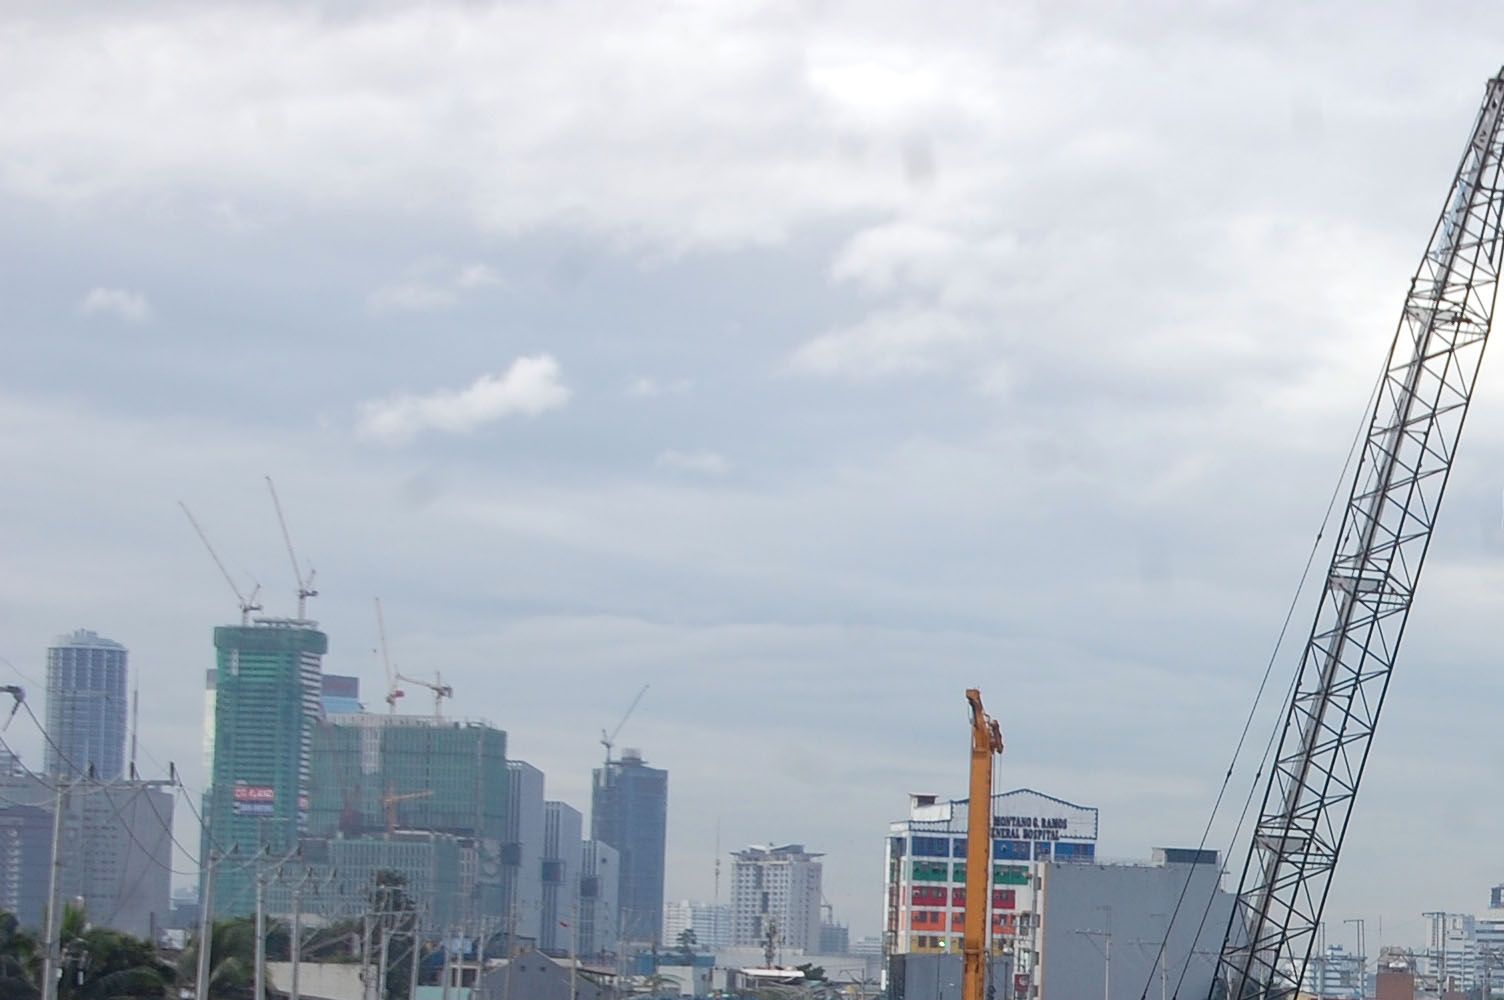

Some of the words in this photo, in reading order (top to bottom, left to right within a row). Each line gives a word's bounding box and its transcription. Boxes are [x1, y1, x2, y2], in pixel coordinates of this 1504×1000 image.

[1041, 818, 1068, 830] RAMOS
[990, 827, 1020, 839] ENERAL
[1022, 829, 1060, 841] HOSPITAL
